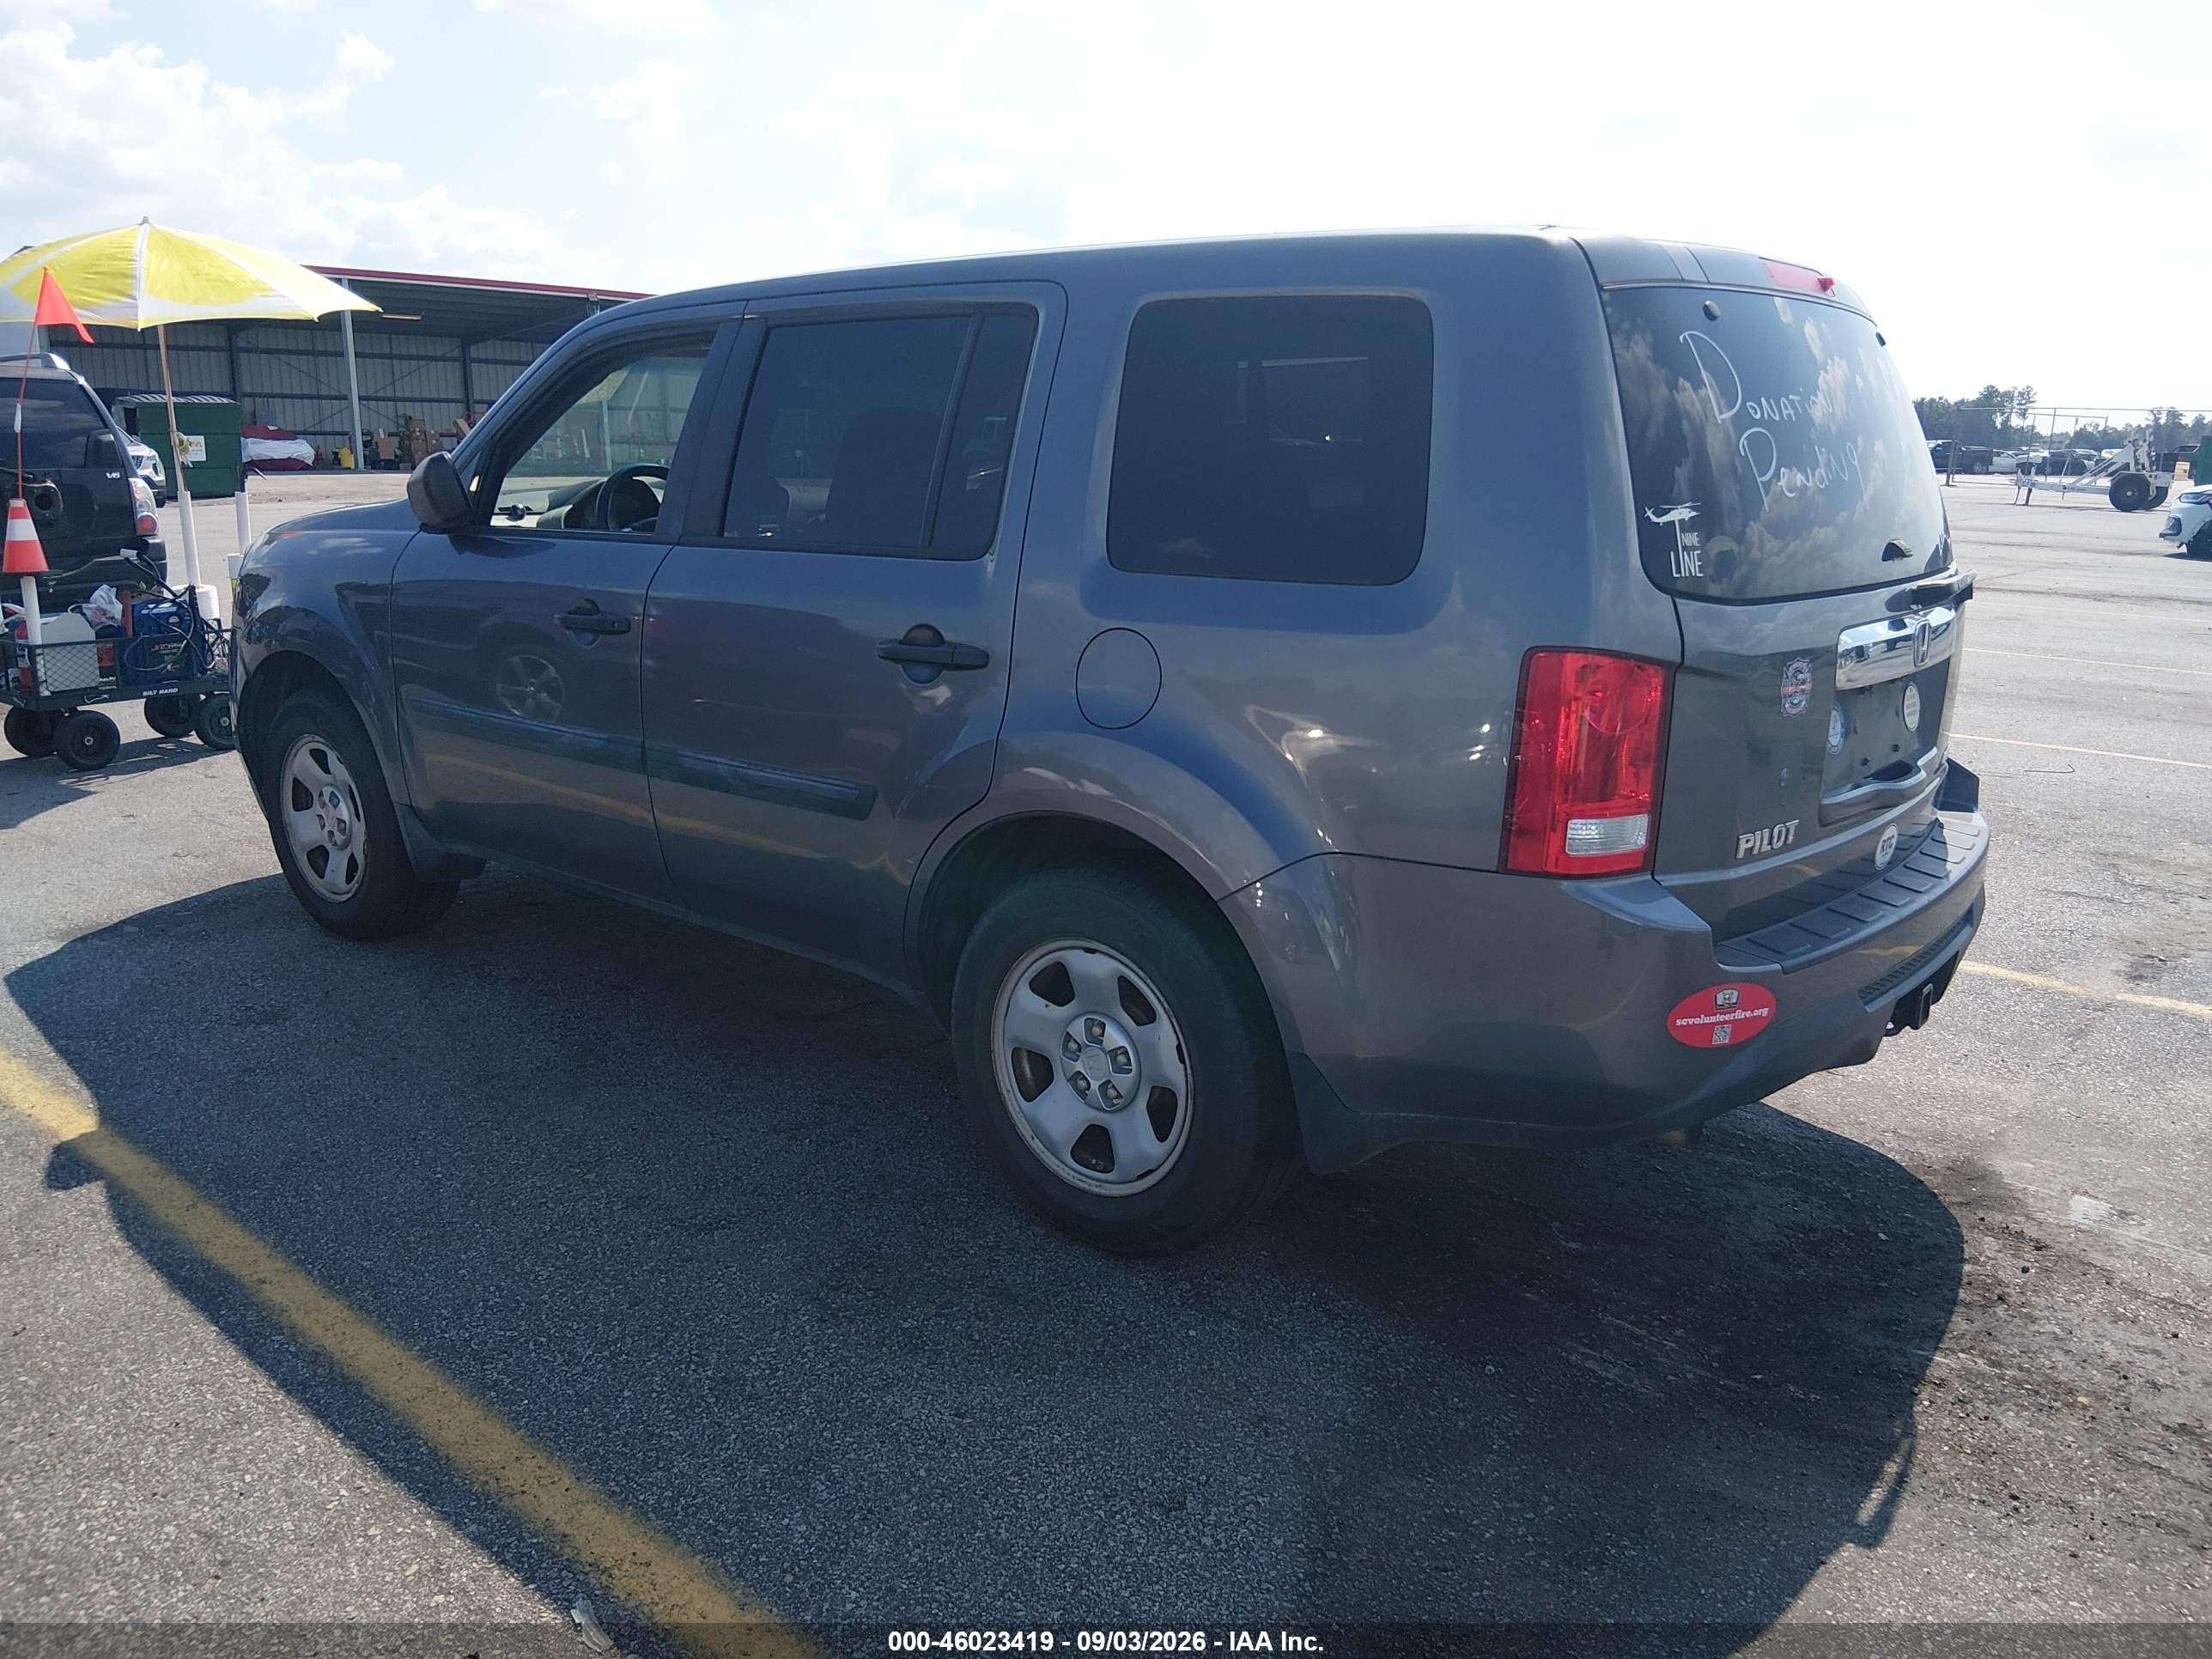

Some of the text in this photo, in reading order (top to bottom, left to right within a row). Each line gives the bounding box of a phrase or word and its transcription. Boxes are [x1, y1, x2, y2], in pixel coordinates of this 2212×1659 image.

[1680, 532, 1701, 546] NINE
[1669, 550, 1705, 578] LINE
[1735, 819, 1800, 860] PILOT
[1675, 1007, 1769, 1026] scvolunteerfire.org
